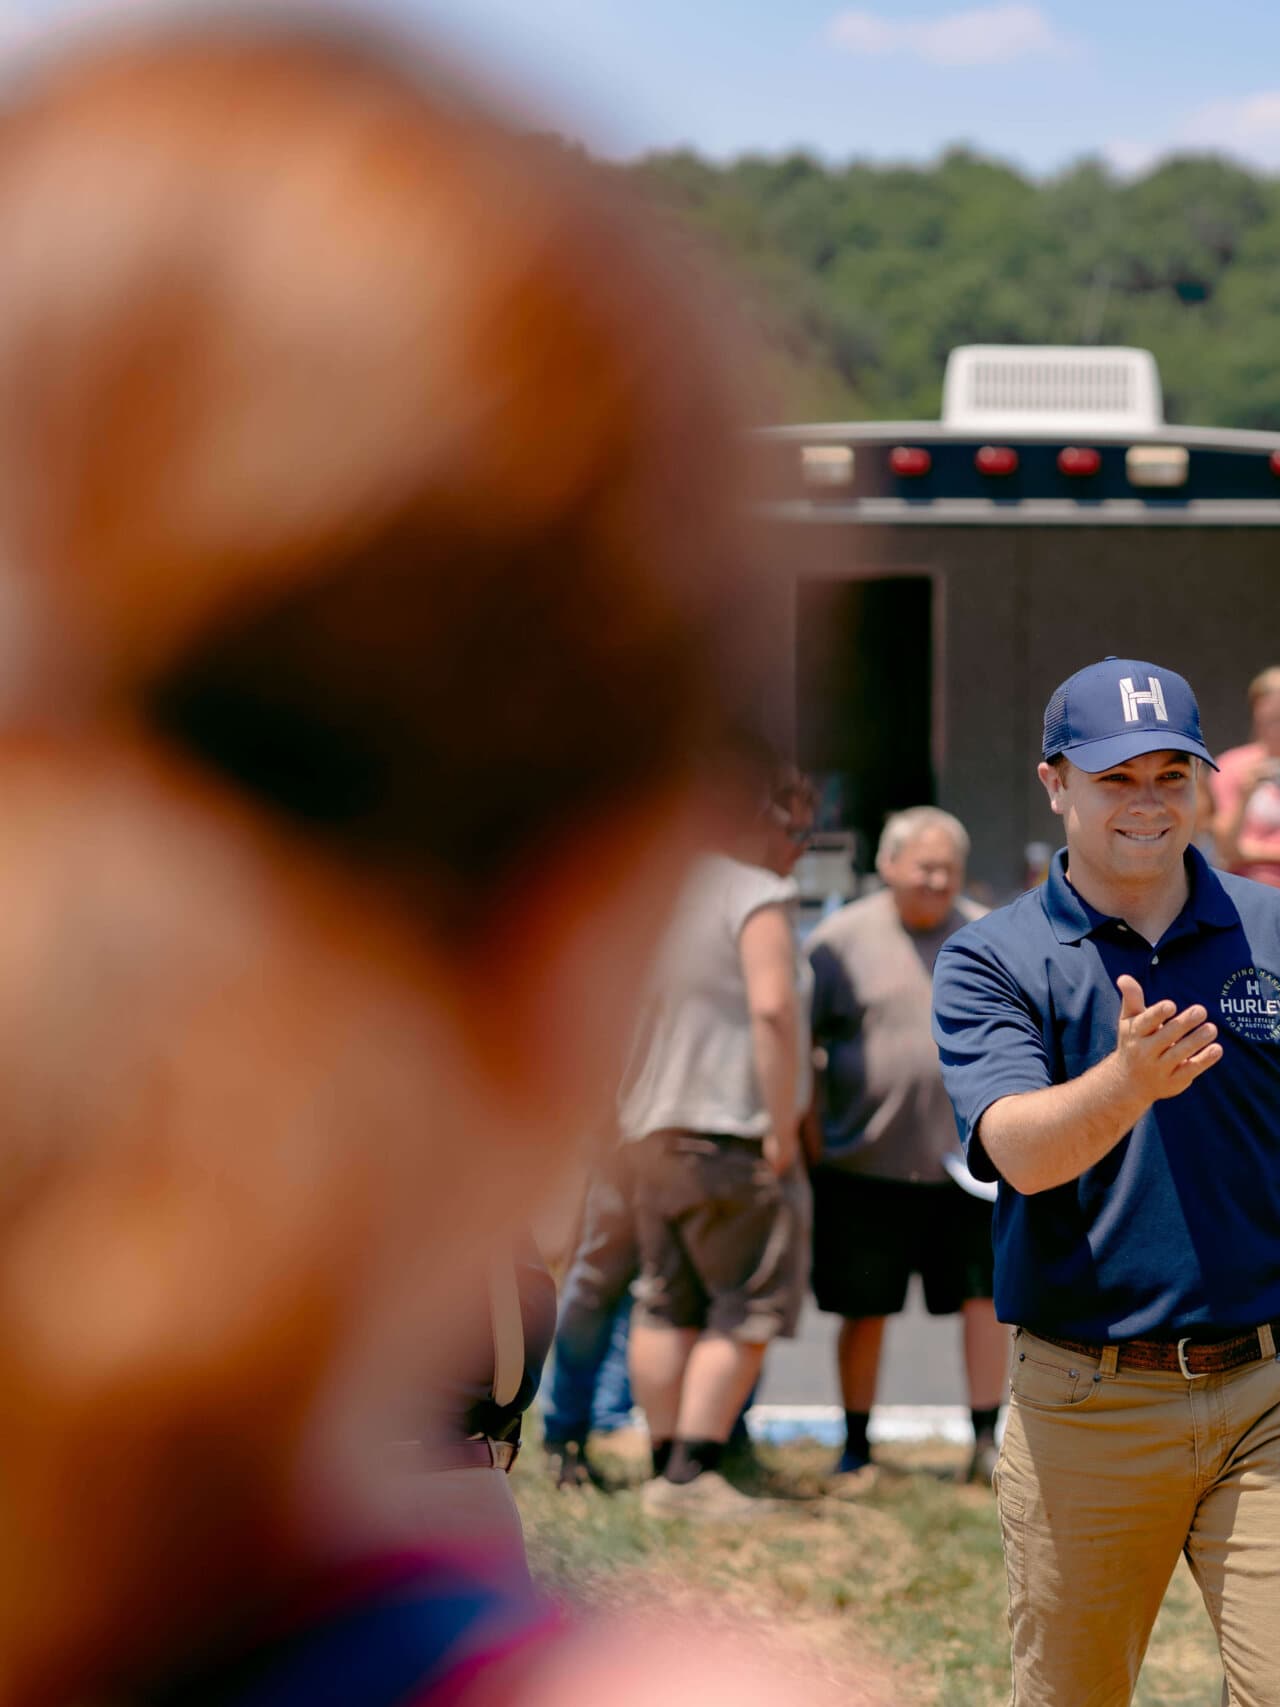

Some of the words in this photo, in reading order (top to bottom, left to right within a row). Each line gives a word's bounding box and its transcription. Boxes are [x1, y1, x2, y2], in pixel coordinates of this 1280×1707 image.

[1119, 677, 1168, 722] H
[1221, 968, 1254, 996] HELPING
[1246, 980, 1260, 995] H
[1225, 1016, 1242, 1032] FOR
[1244, 1032, 1261, 1040] ALL
